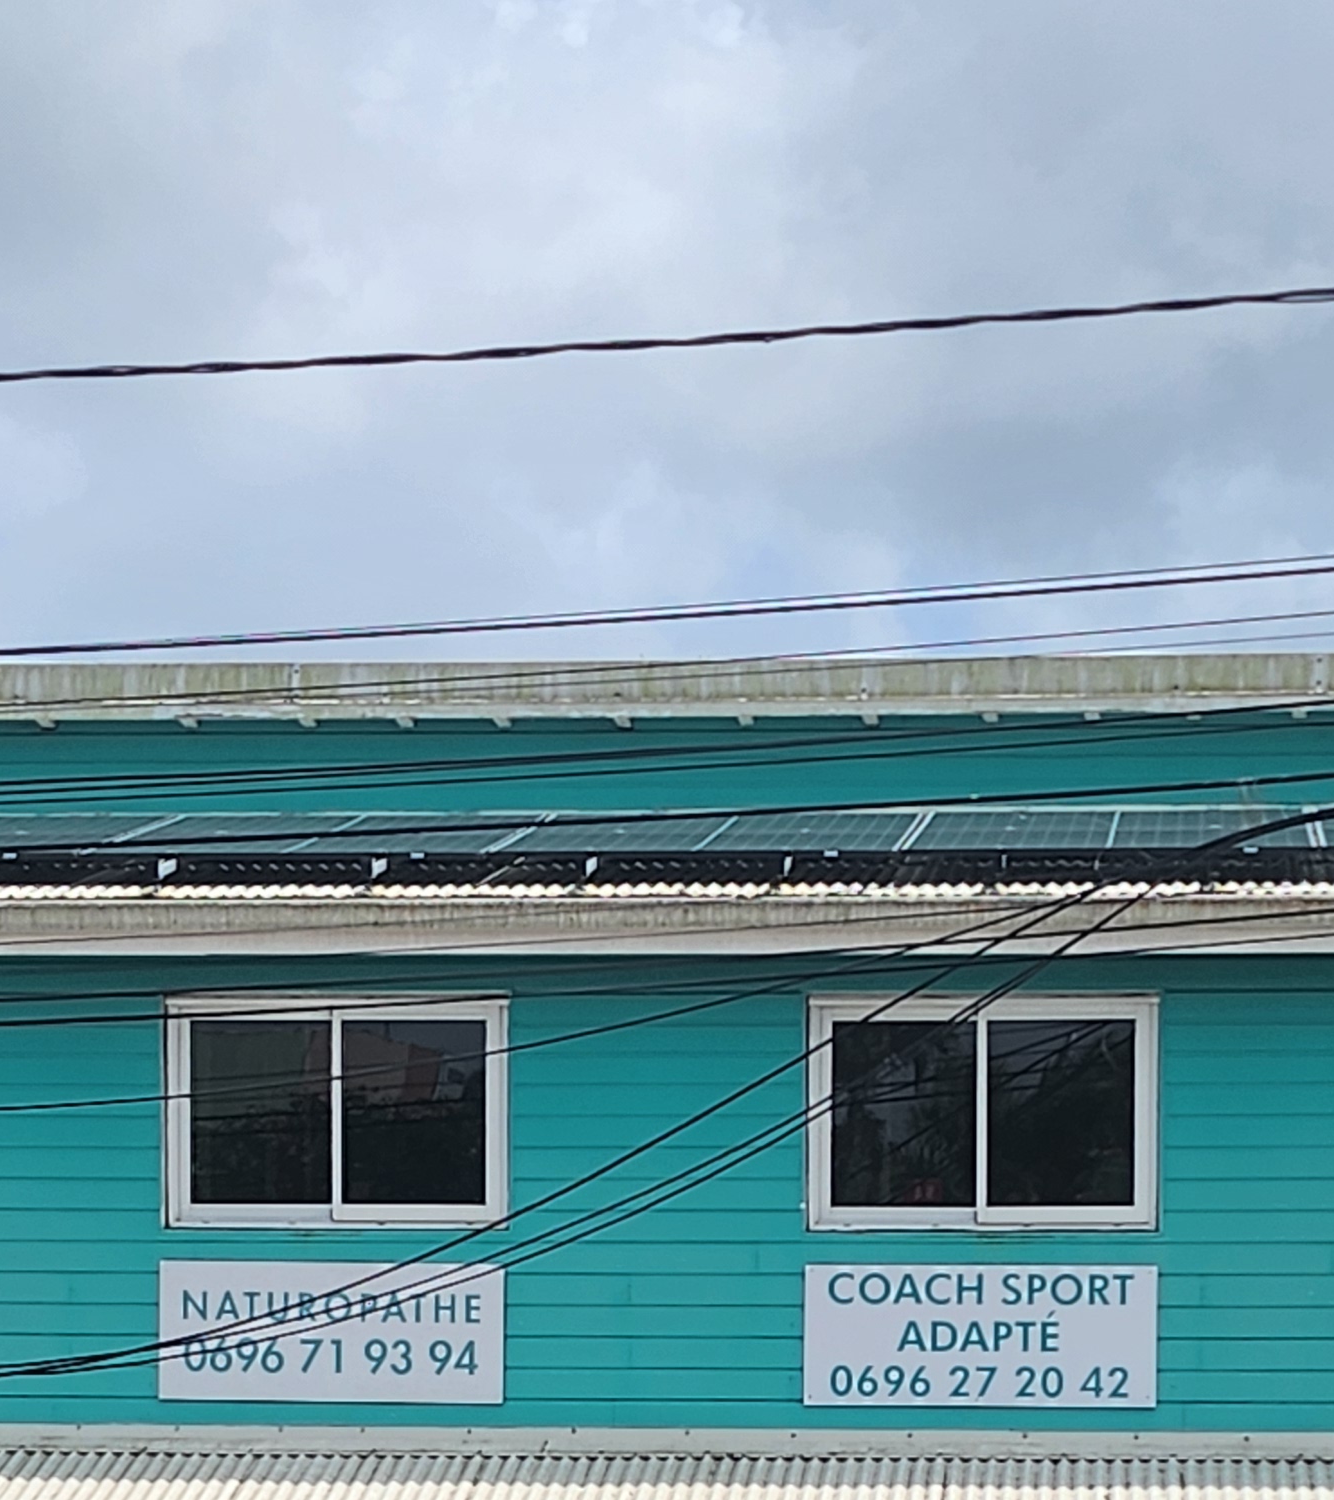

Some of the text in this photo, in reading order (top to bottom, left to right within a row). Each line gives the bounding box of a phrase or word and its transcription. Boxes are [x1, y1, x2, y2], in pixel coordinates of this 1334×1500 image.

[182, 1289, 482, 1324] NATUROPATHE
[827, 1272, 1135, 1306] COACH SPORT
[896, 1310, 1060, 1352] ADAPTÉ
[183, 1338, 479, 1376] 0696 71 93 94
[829, 1365, 1130, 1399] 0696 27 20 42
